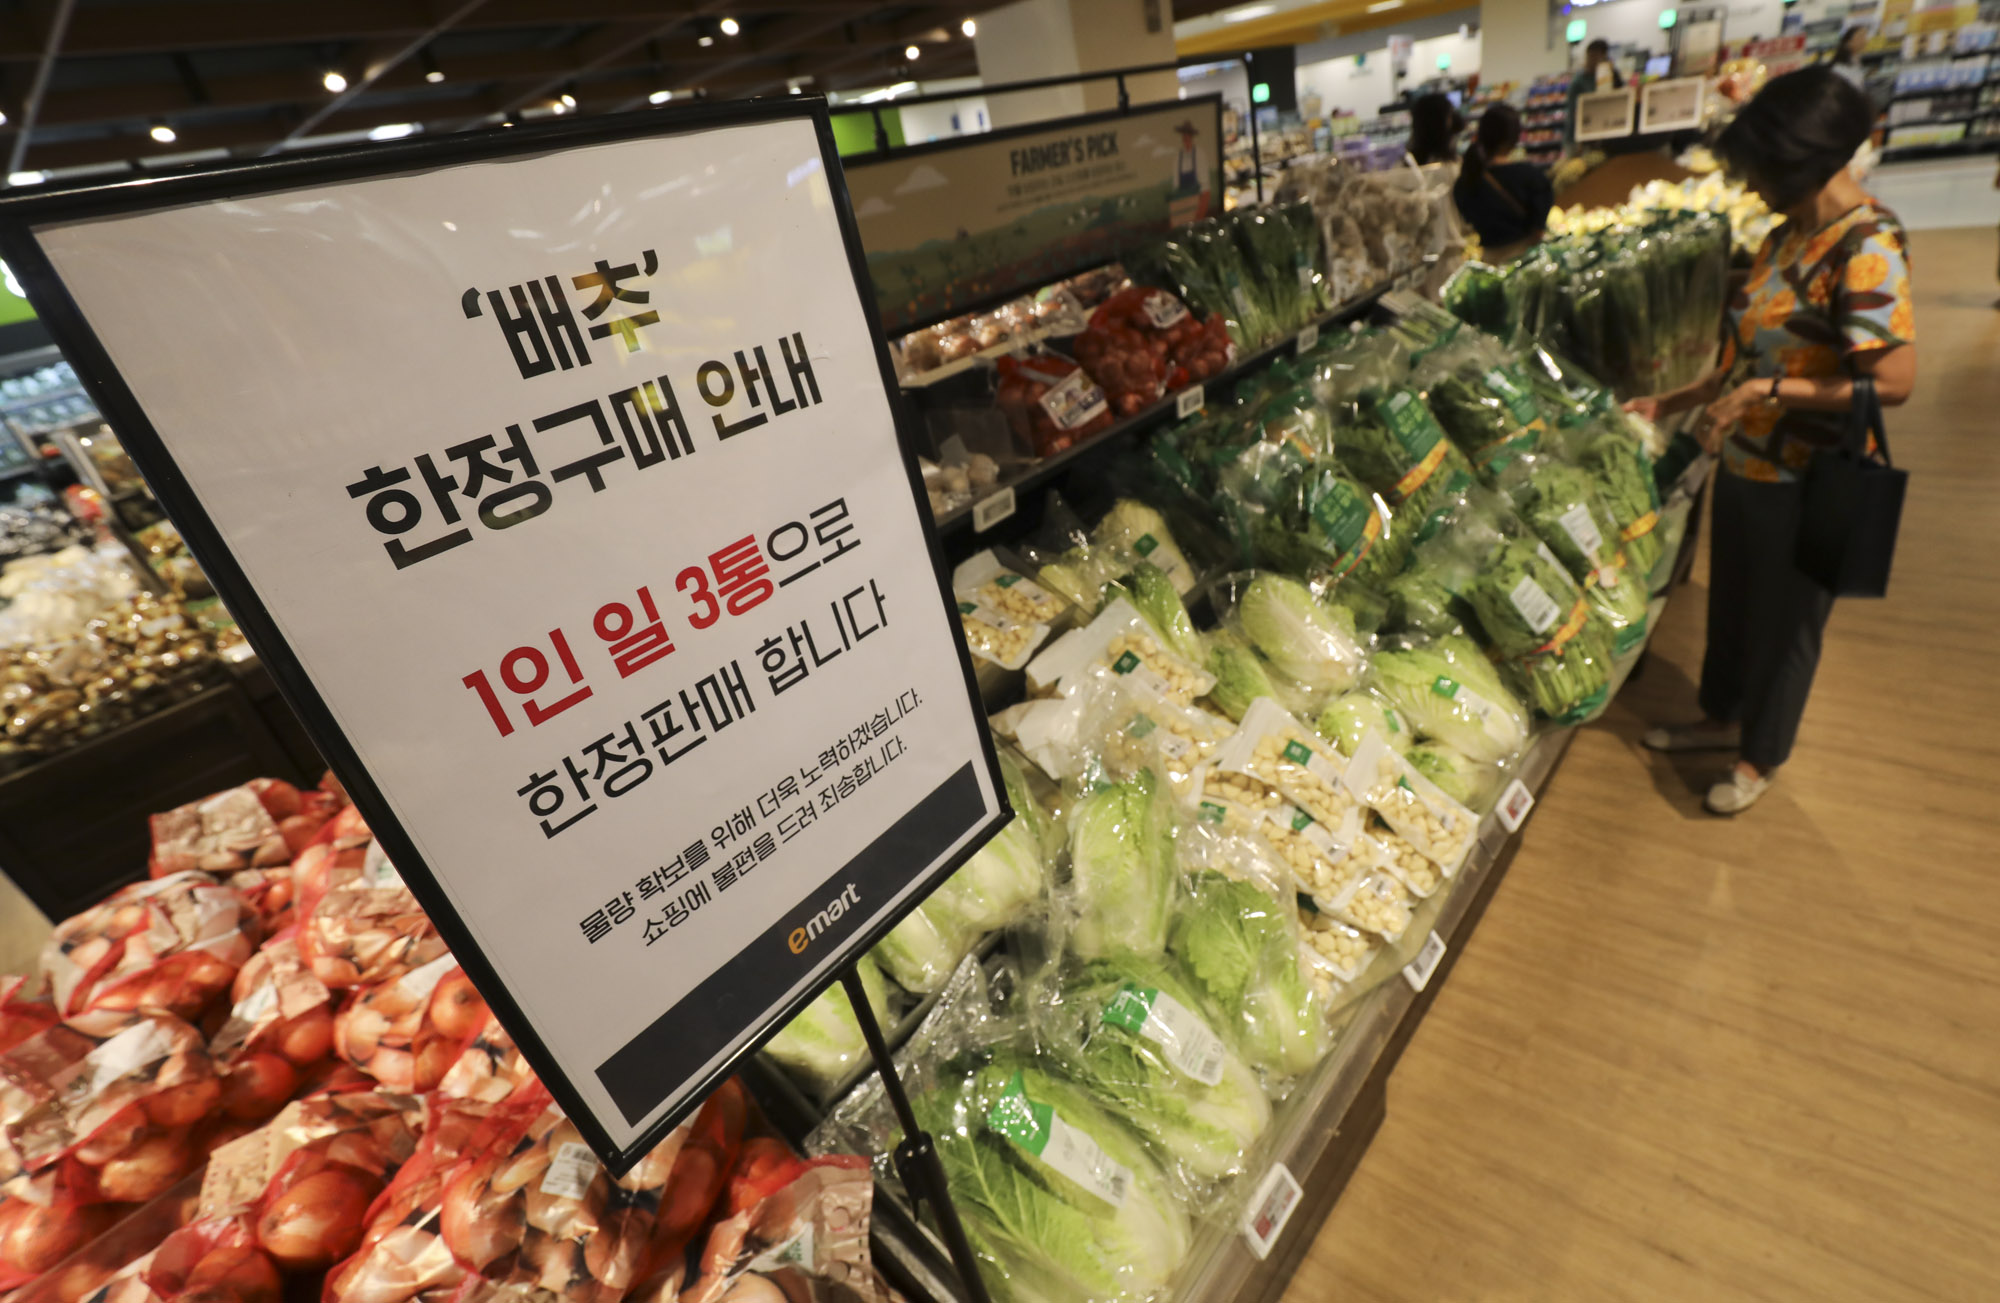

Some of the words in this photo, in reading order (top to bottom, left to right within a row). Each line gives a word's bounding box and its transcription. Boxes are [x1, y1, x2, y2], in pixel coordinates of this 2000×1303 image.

[1086, 131, 1119, 161] PICK
[346, 374, 695, 571] 한정구매
[696, 331, 823, 441] 안내
[462, 627, 594, 738] 1인
[593, 585, 676, 680] 일
[675, 497, 861, 630] 3통으로
[516, 660, 756, 840] 한정판매
[755, 578, 888, 697] 합니다
[579, 891, 637, 945] 물량
[635, 839, 711, 900] 확보를
[711, 805, 757, 850] 위해
[756, 775, 800, 819] 더욱
[800, 687, 923, 789] 노력하겠습니다.
[642, 880, 712, 947] 쇼핑에
[711, 831, 778, 893] 불편을
[776, 800, 818, 844] 드려
[817, 735, 908, 813] 죄송합니다.
[787, 883, 862, 955] emart
